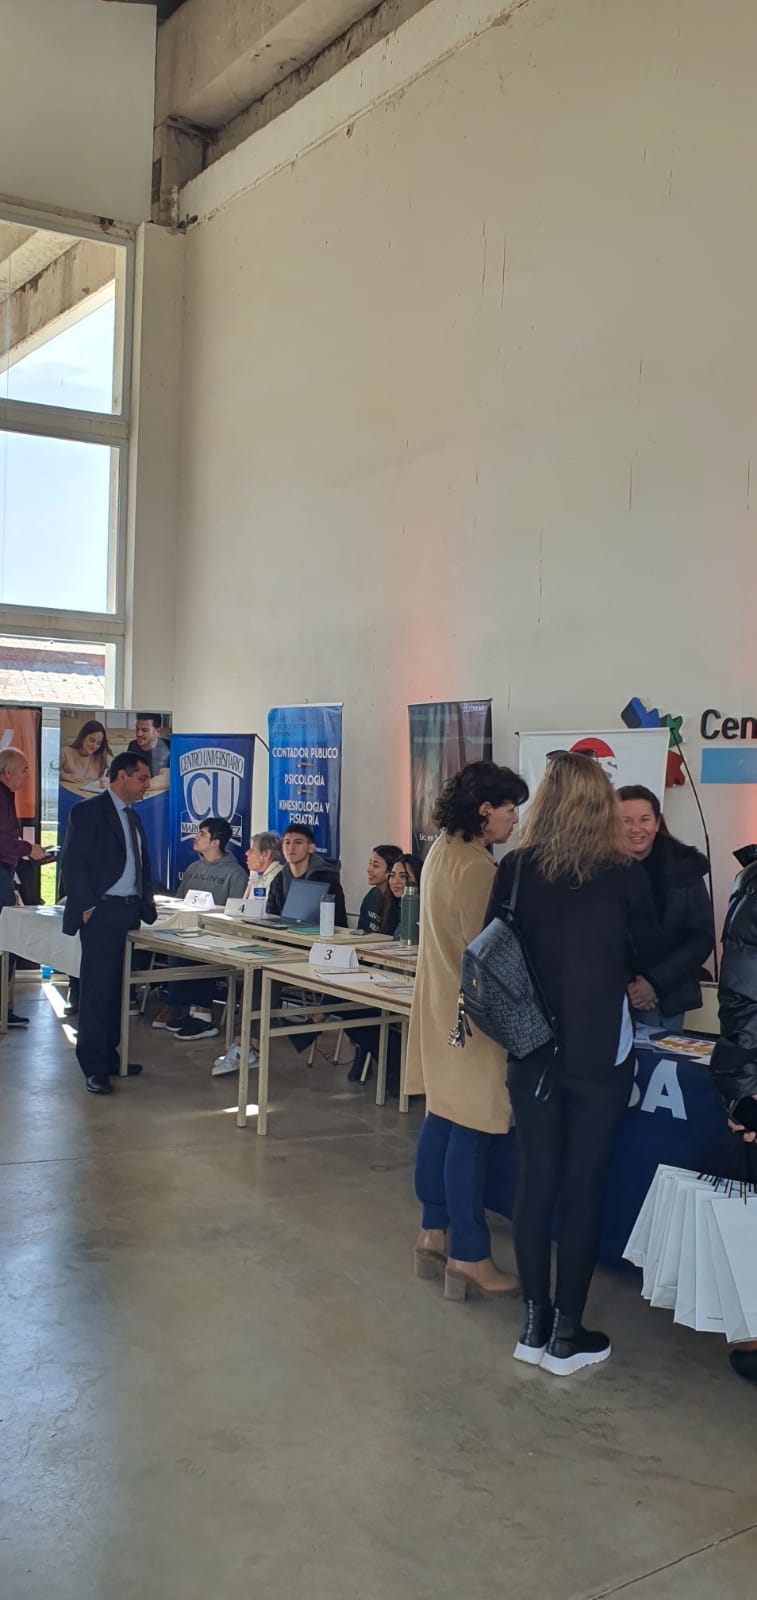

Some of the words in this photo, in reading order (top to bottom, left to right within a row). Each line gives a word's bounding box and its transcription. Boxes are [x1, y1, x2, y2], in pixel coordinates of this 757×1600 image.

[272, 747, 309, 758] CONTADOR
[180, 750, 203, 772] CENTRO
[203, 749, 244, 774] UNIVERSITARIO
[284, 771, 325, 786] PSICOLOGÍA
[187, 771, 235, 820] CU
[278, 798, 324, 813] KINESIOLOGÍA
[289, 812, 320, 826] FISIATRÍA
[191, 895, 198, 905] 5
[239, 903, 246, 913] 4
[324, 949, 333, 961] 3
